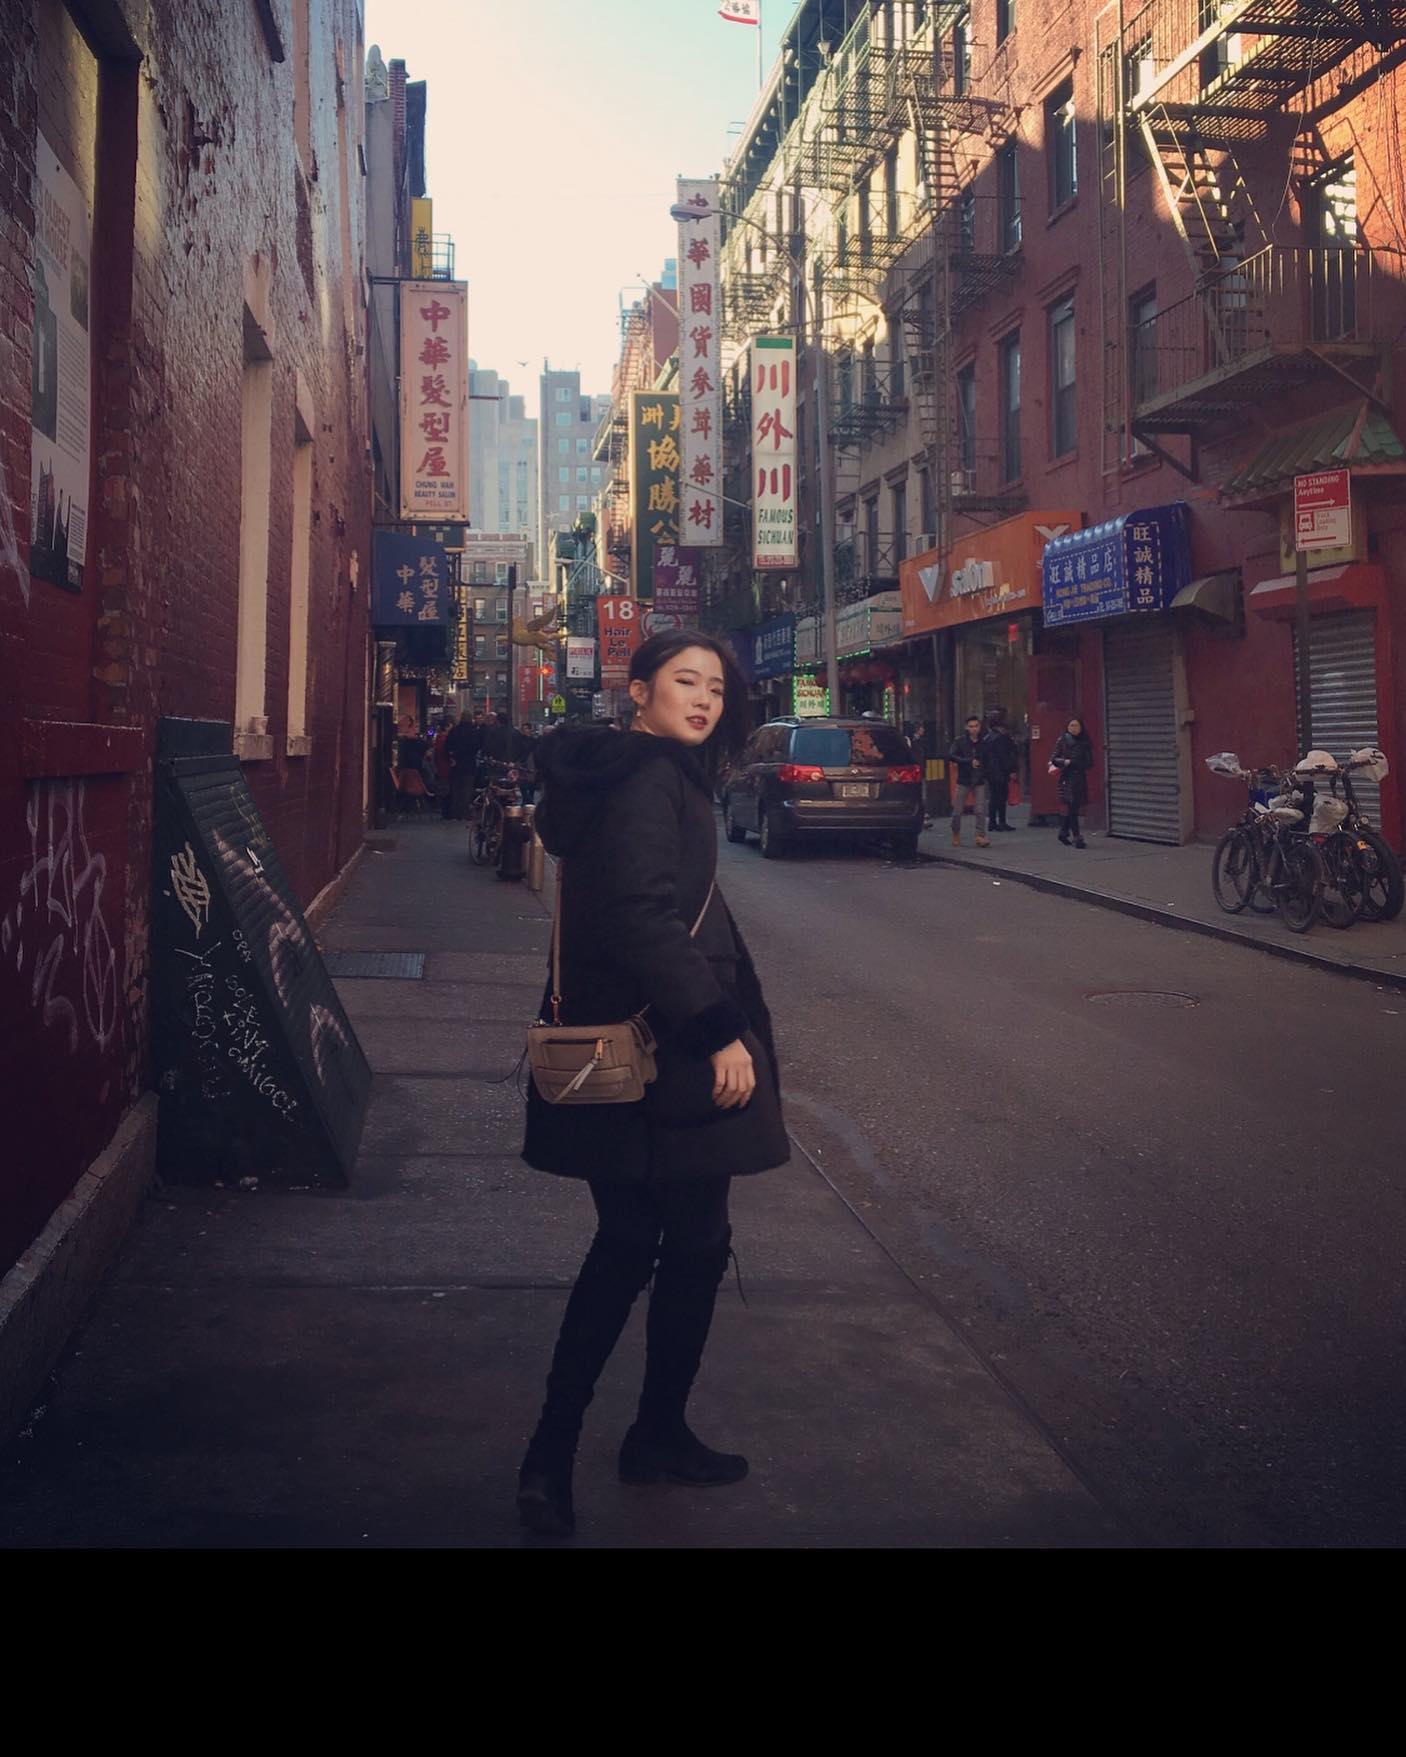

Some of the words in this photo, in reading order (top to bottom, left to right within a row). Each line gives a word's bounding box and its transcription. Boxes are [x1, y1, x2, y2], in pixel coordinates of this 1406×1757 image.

[416, 299, 452, 477] 中華髮型屋
[757, 359, 793, 502] 川外川
[1297, 479, 1307, 488] NO
[1308, 474, 1340, 487] STANDING
[414, 490, 436, 498] BEAUTY
[438, 490, 456, 499] SALON
[1298, 487, 1325, 497] Anytime
[758, 508, 793, 524] FAMOUS
[757, 529, 794, 545] SICHUAN
[1132, 526, 1154, 604] 旺誠精品
[396, 564, 416, 613] 中華
[603, 600, 634, 620] 18
[604, 627, 631, 637] Hair
